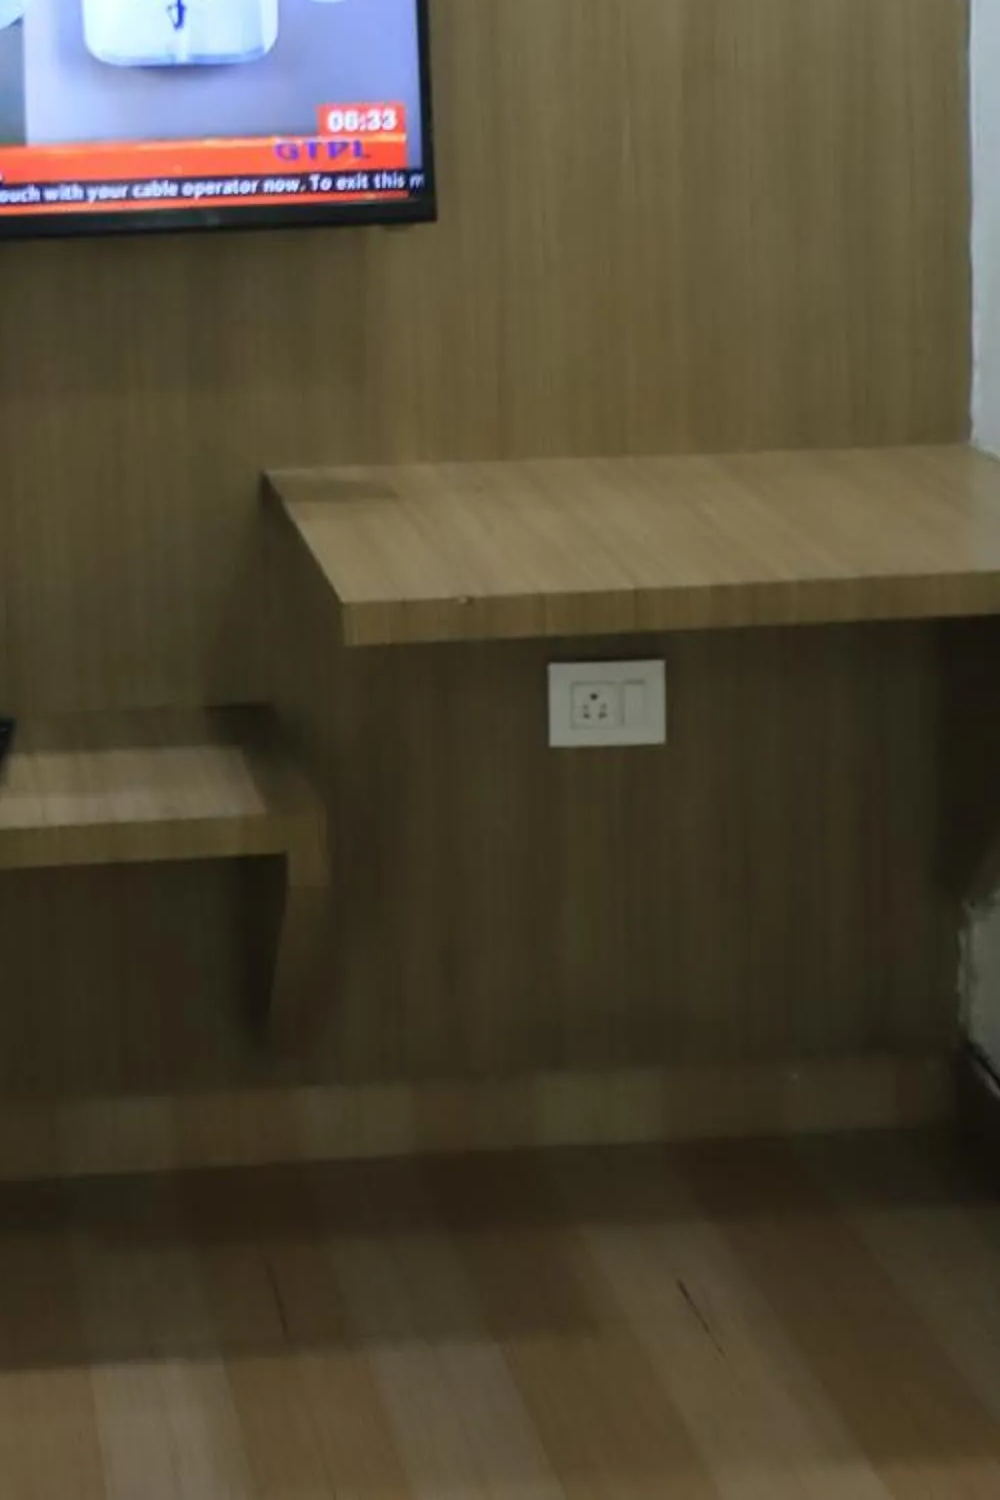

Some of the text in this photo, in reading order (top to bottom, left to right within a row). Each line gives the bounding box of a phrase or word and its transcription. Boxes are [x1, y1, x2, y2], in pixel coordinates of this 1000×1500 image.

[44, 182, 84, 201] with
[86, 184, 130, 204] your
[133, 180, 176, 198] cable
[181, 178, 260, 199] operator
[263, 180, 305, 193] now.
[309, 173, 332, 190] To
[336, 171, 370, 189] exit
[374, 169, 405, 189] this
